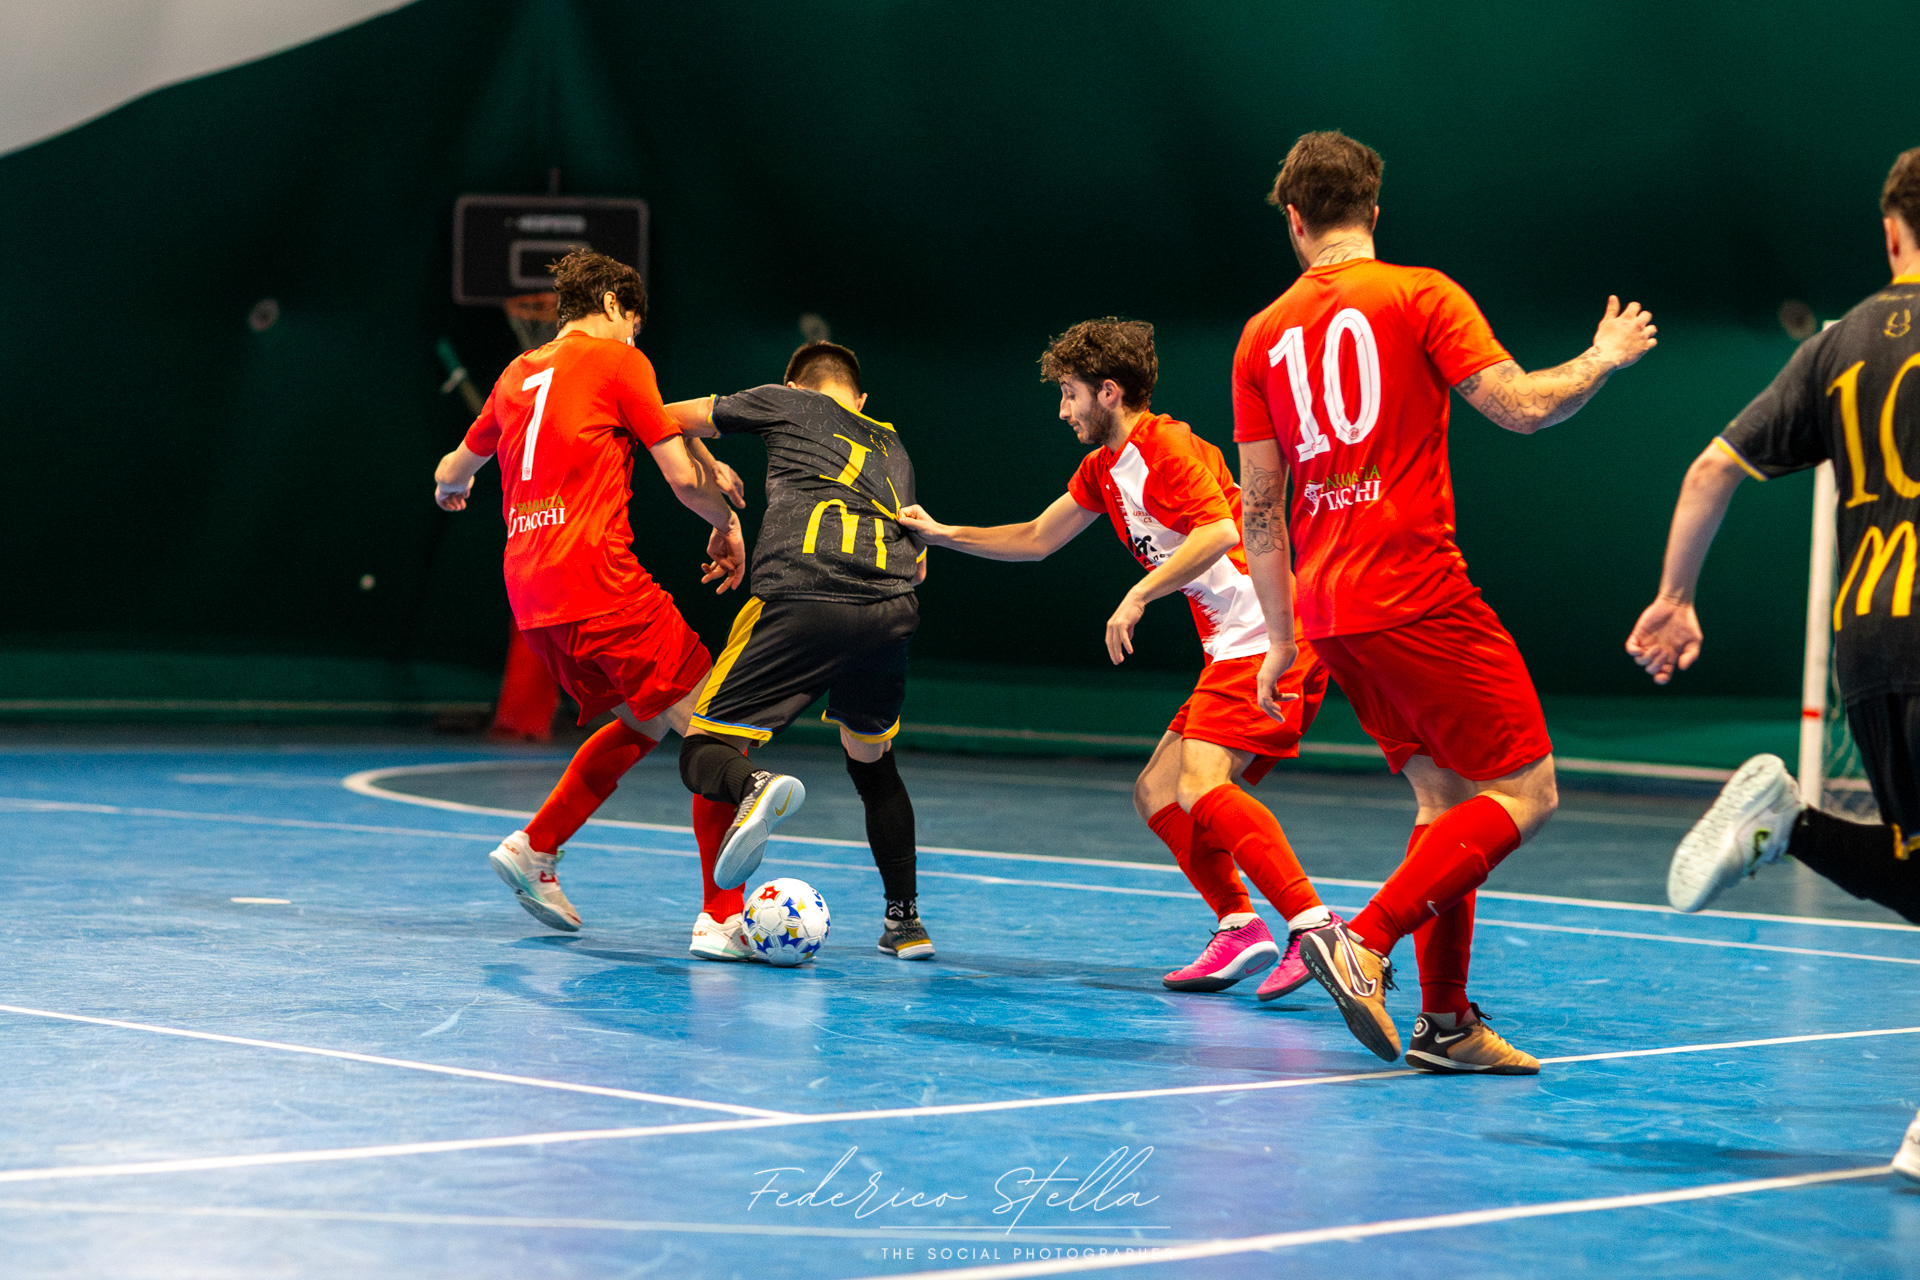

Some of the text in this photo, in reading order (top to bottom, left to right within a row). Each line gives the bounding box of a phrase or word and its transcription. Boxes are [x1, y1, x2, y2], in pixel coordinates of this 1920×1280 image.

[522, 367, 555, 482] 7
[1267, 307, 1382, 462] 10
[517, 507, 566, 533] TACCHI
